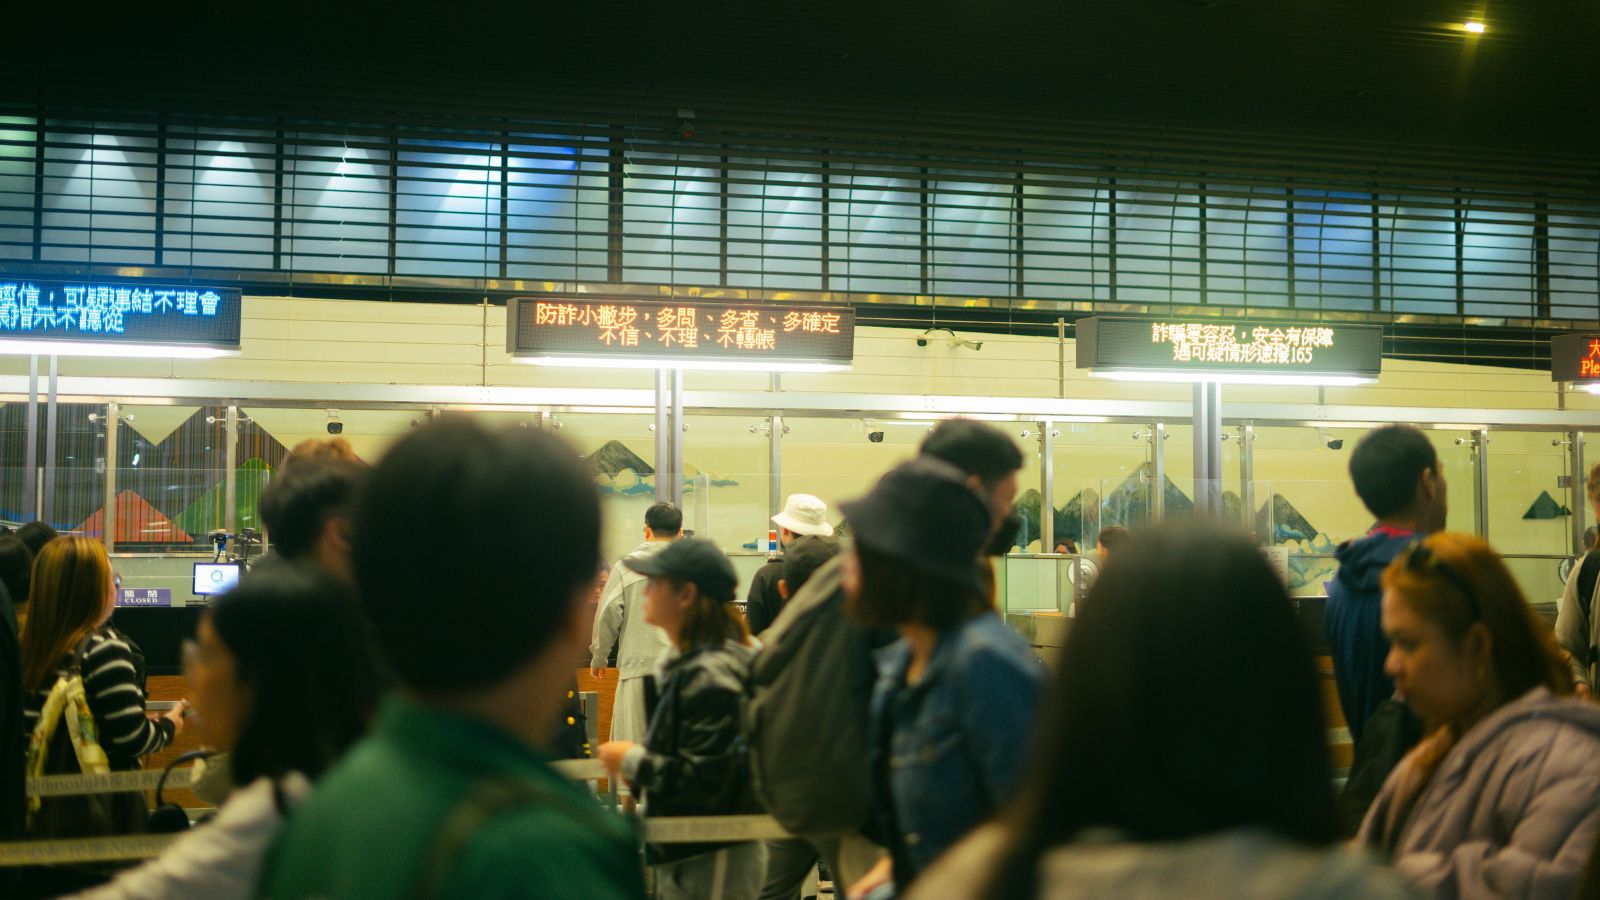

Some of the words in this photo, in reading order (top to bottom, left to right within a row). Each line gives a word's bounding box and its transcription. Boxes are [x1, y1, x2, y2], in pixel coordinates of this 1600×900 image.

[536, 302, 839, 333] 防詐小撇步，多問、多查、多確定
[598, 325, 775, 350] 不信、不理、不轉帳
